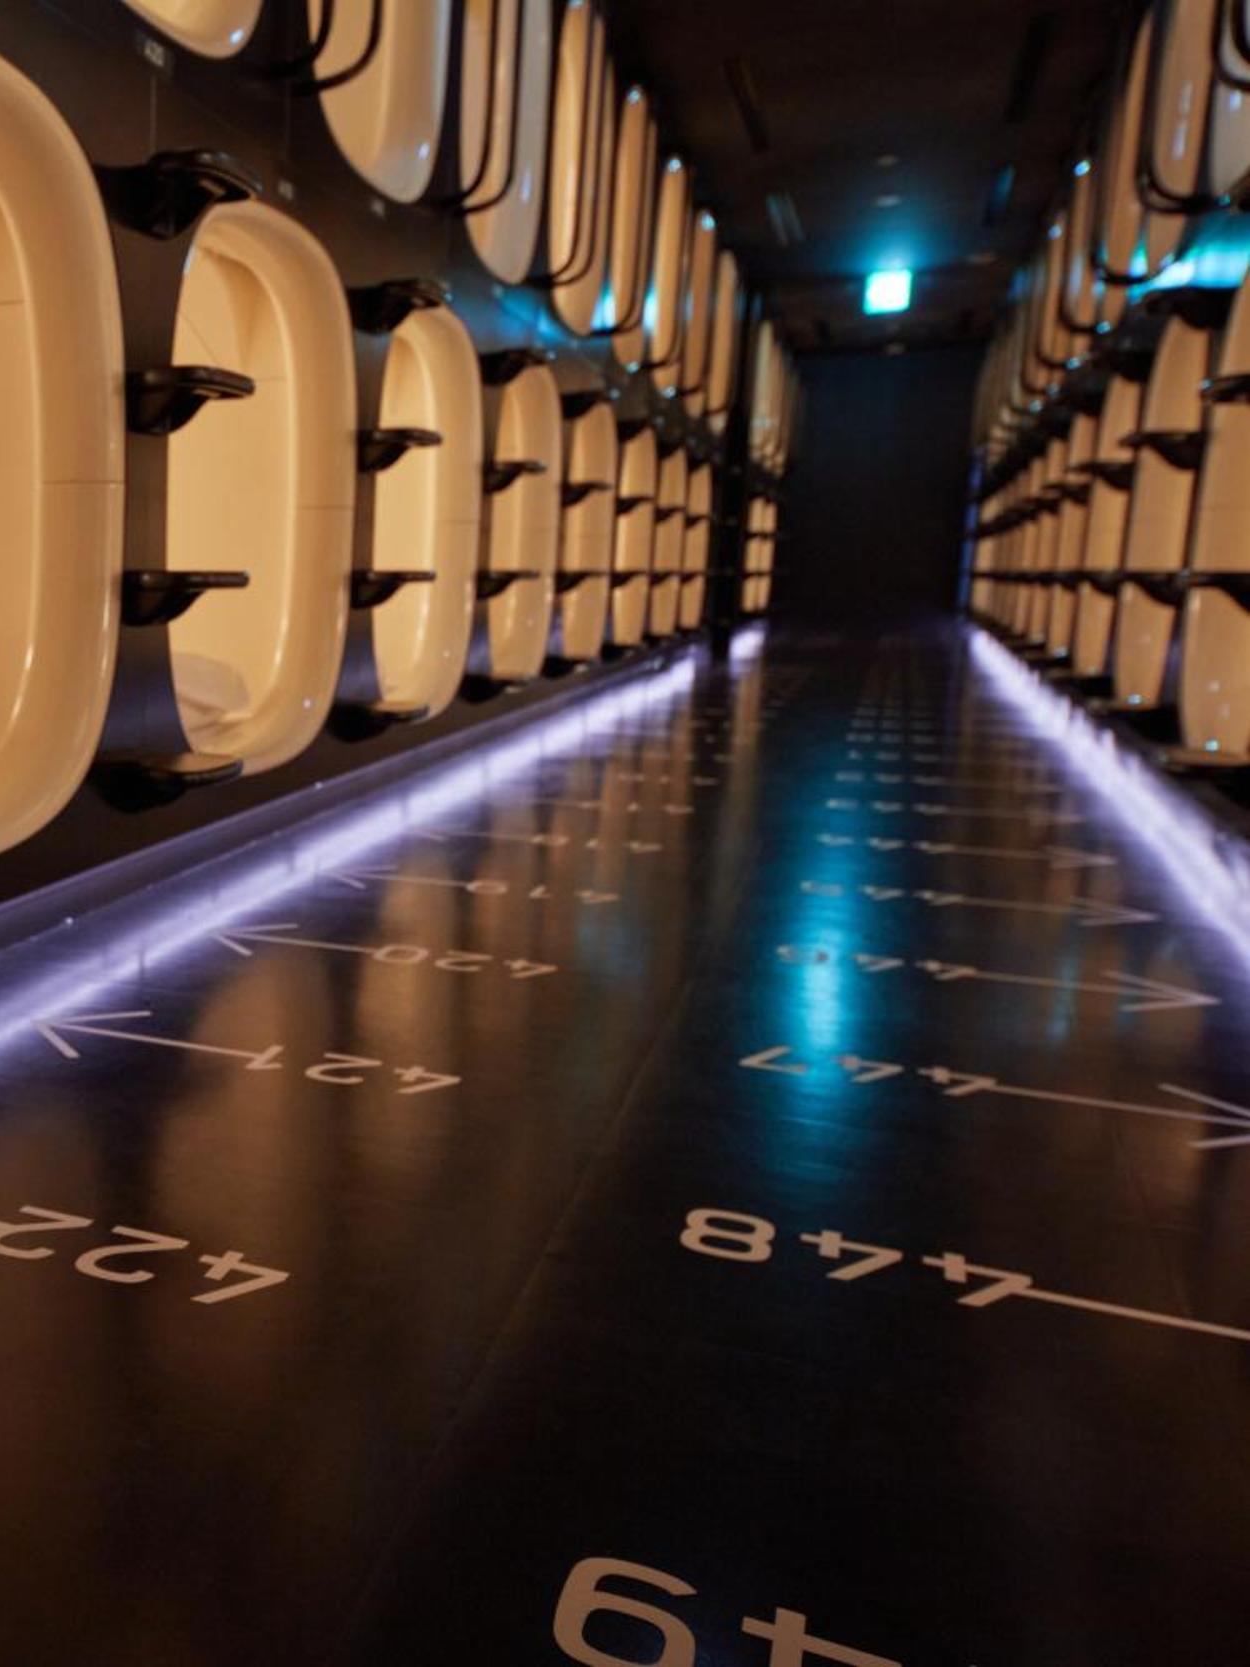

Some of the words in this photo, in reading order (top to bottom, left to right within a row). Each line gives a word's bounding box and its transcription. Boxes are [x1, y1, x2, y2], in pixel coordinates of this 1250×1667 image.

[372, 944, 561, 979] 420
[244, 1045, 462, 1094] 421
[738, 1046, 998, 1097] 447
[680, 1208, 1034, 1307] 448
